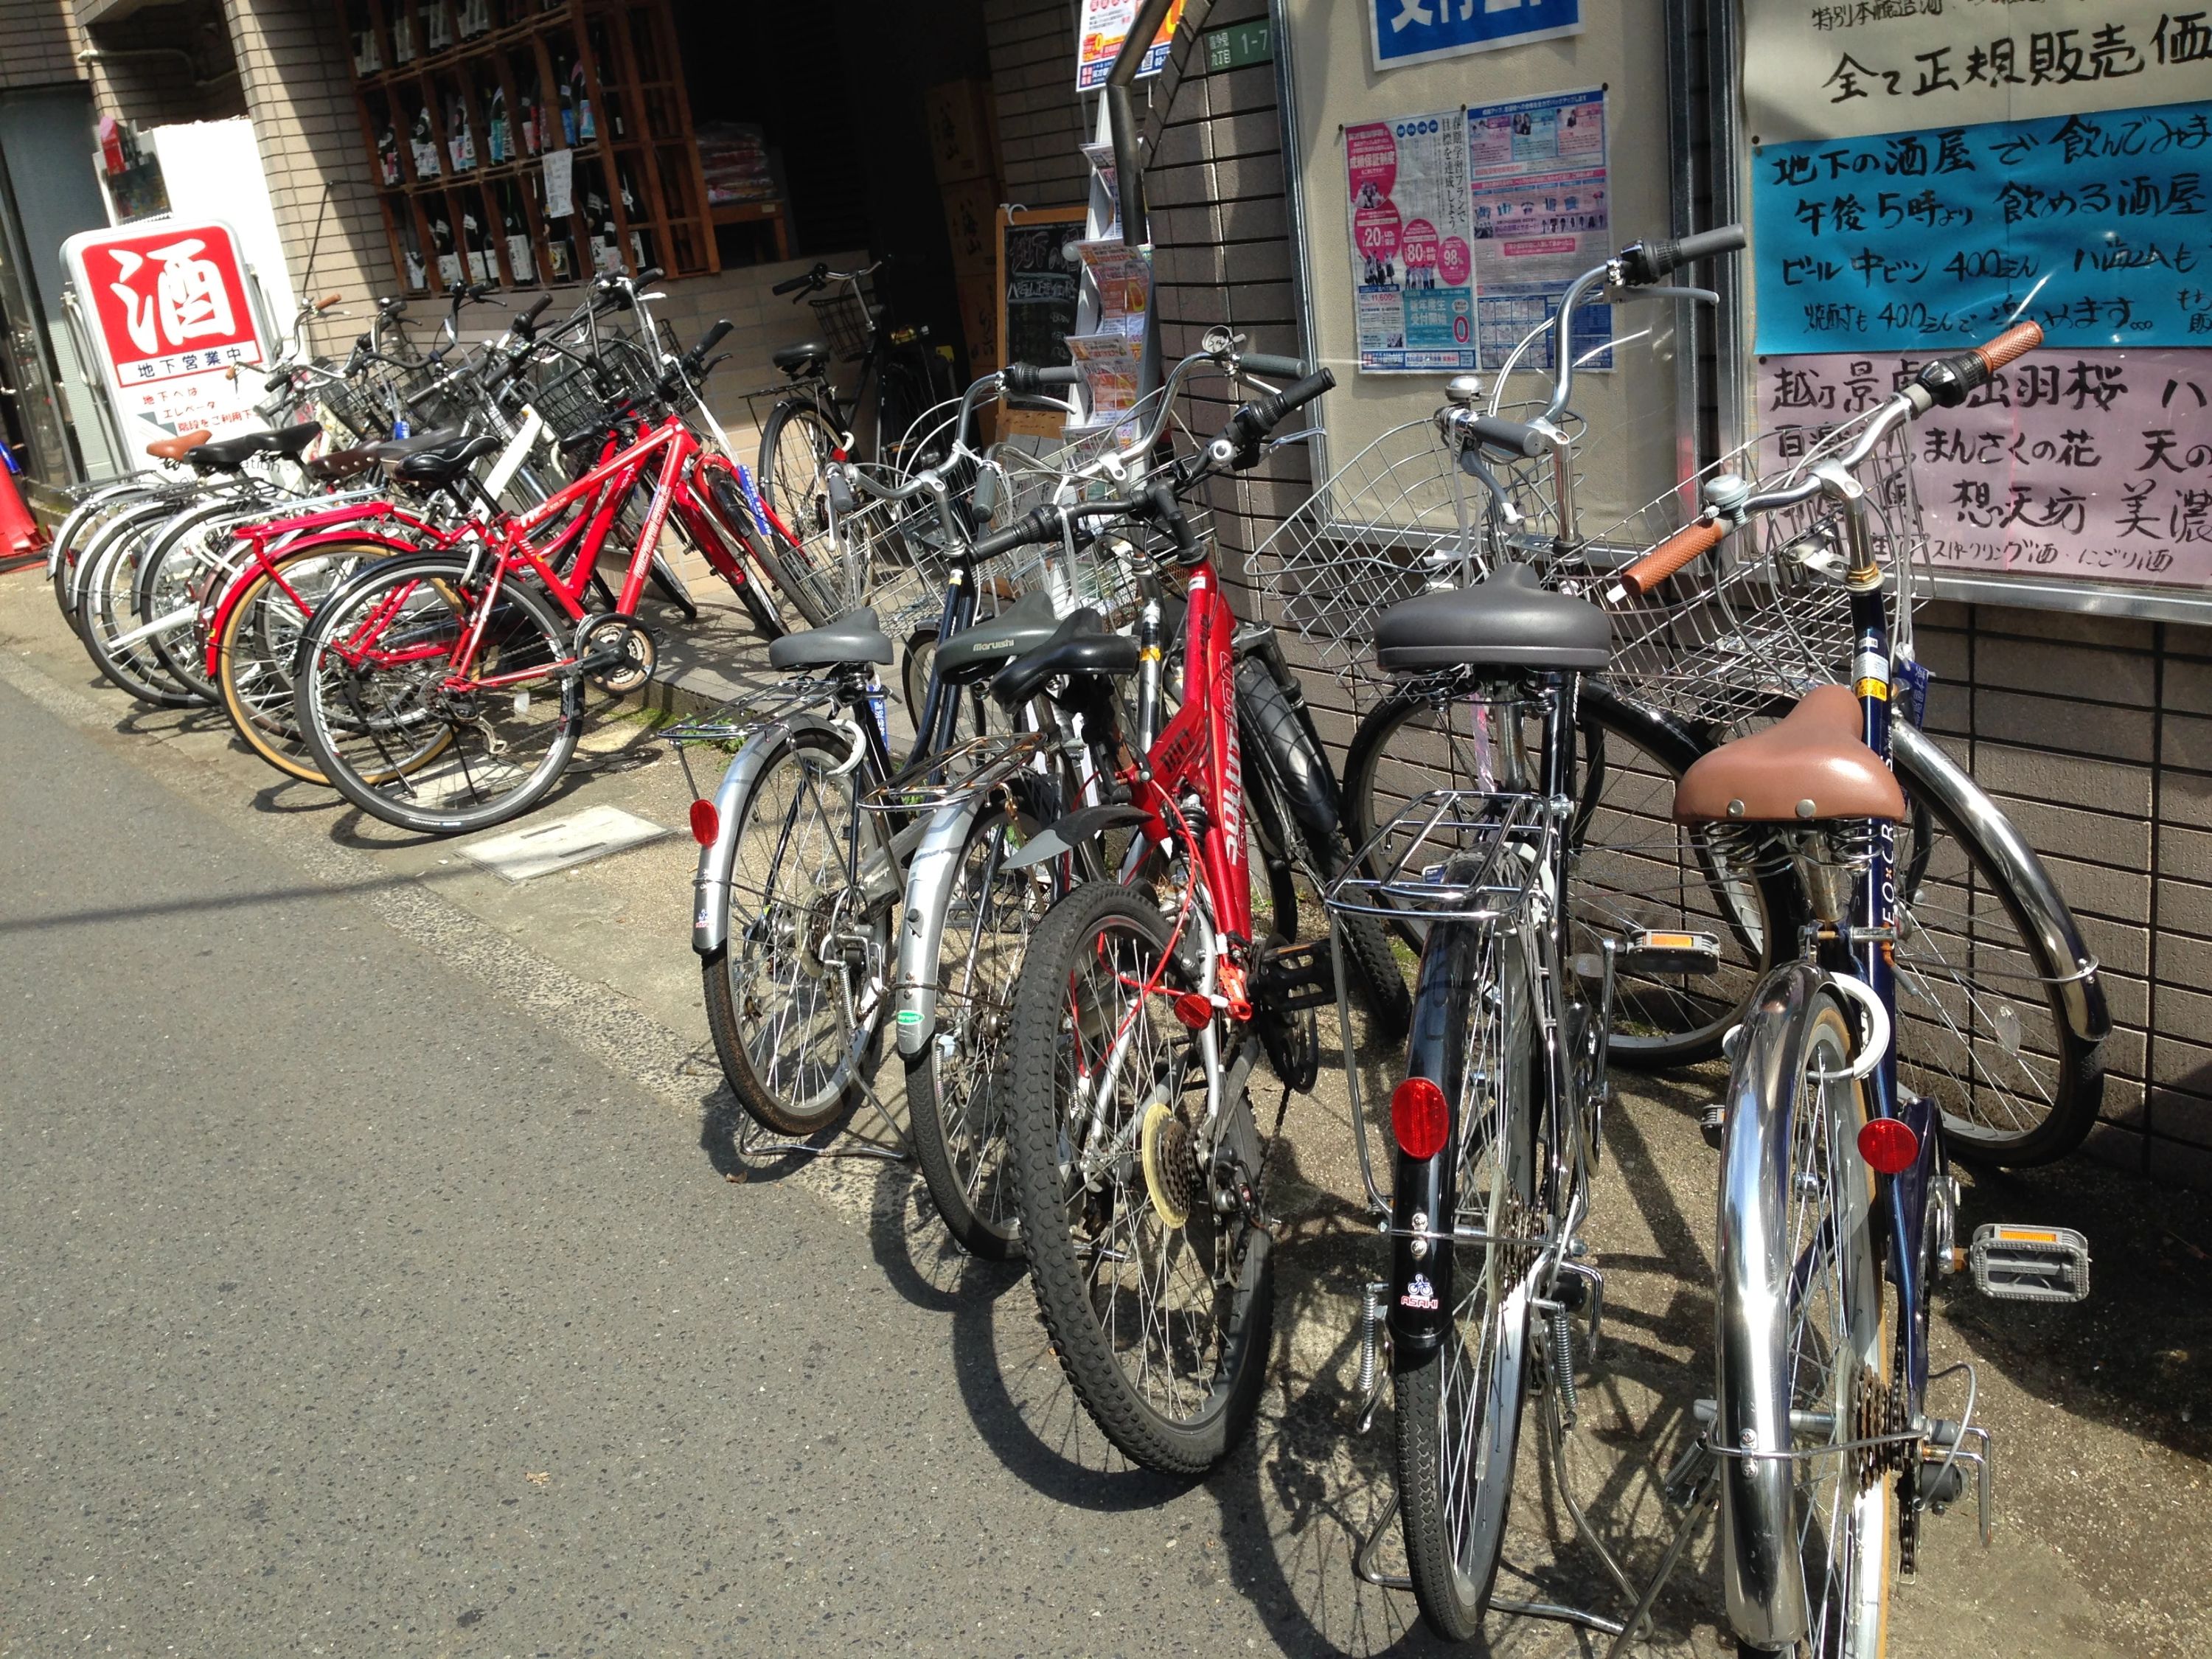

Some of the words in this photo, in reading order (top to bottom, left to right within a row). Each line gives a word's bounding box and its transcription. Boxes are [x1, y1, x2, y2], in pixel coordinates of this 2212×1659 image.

[1241, 29, 1267, 55] 1-7
[1819, 12, 2212, 103] 全て正規販売価
[1441, 118, 1458, 234] 目標を達成しよう。
[1365, 226, 1381, 247] 20
[1407, 243, 1423, 262] 80
[108, 237, 236, 355] 酒
[136, 348, 242, 378] 地下営業中
[142, 387, 198, 406] 地下へは
[163, 401, 216, 419] エレベータ
[1923, 428, 2102, 467] まんさくの花
[2135, 429, 2212, 473] 天の
[973, 639, 1015, 652] maruishi
[1400, 1295, 1439, 1310] ASAHI
